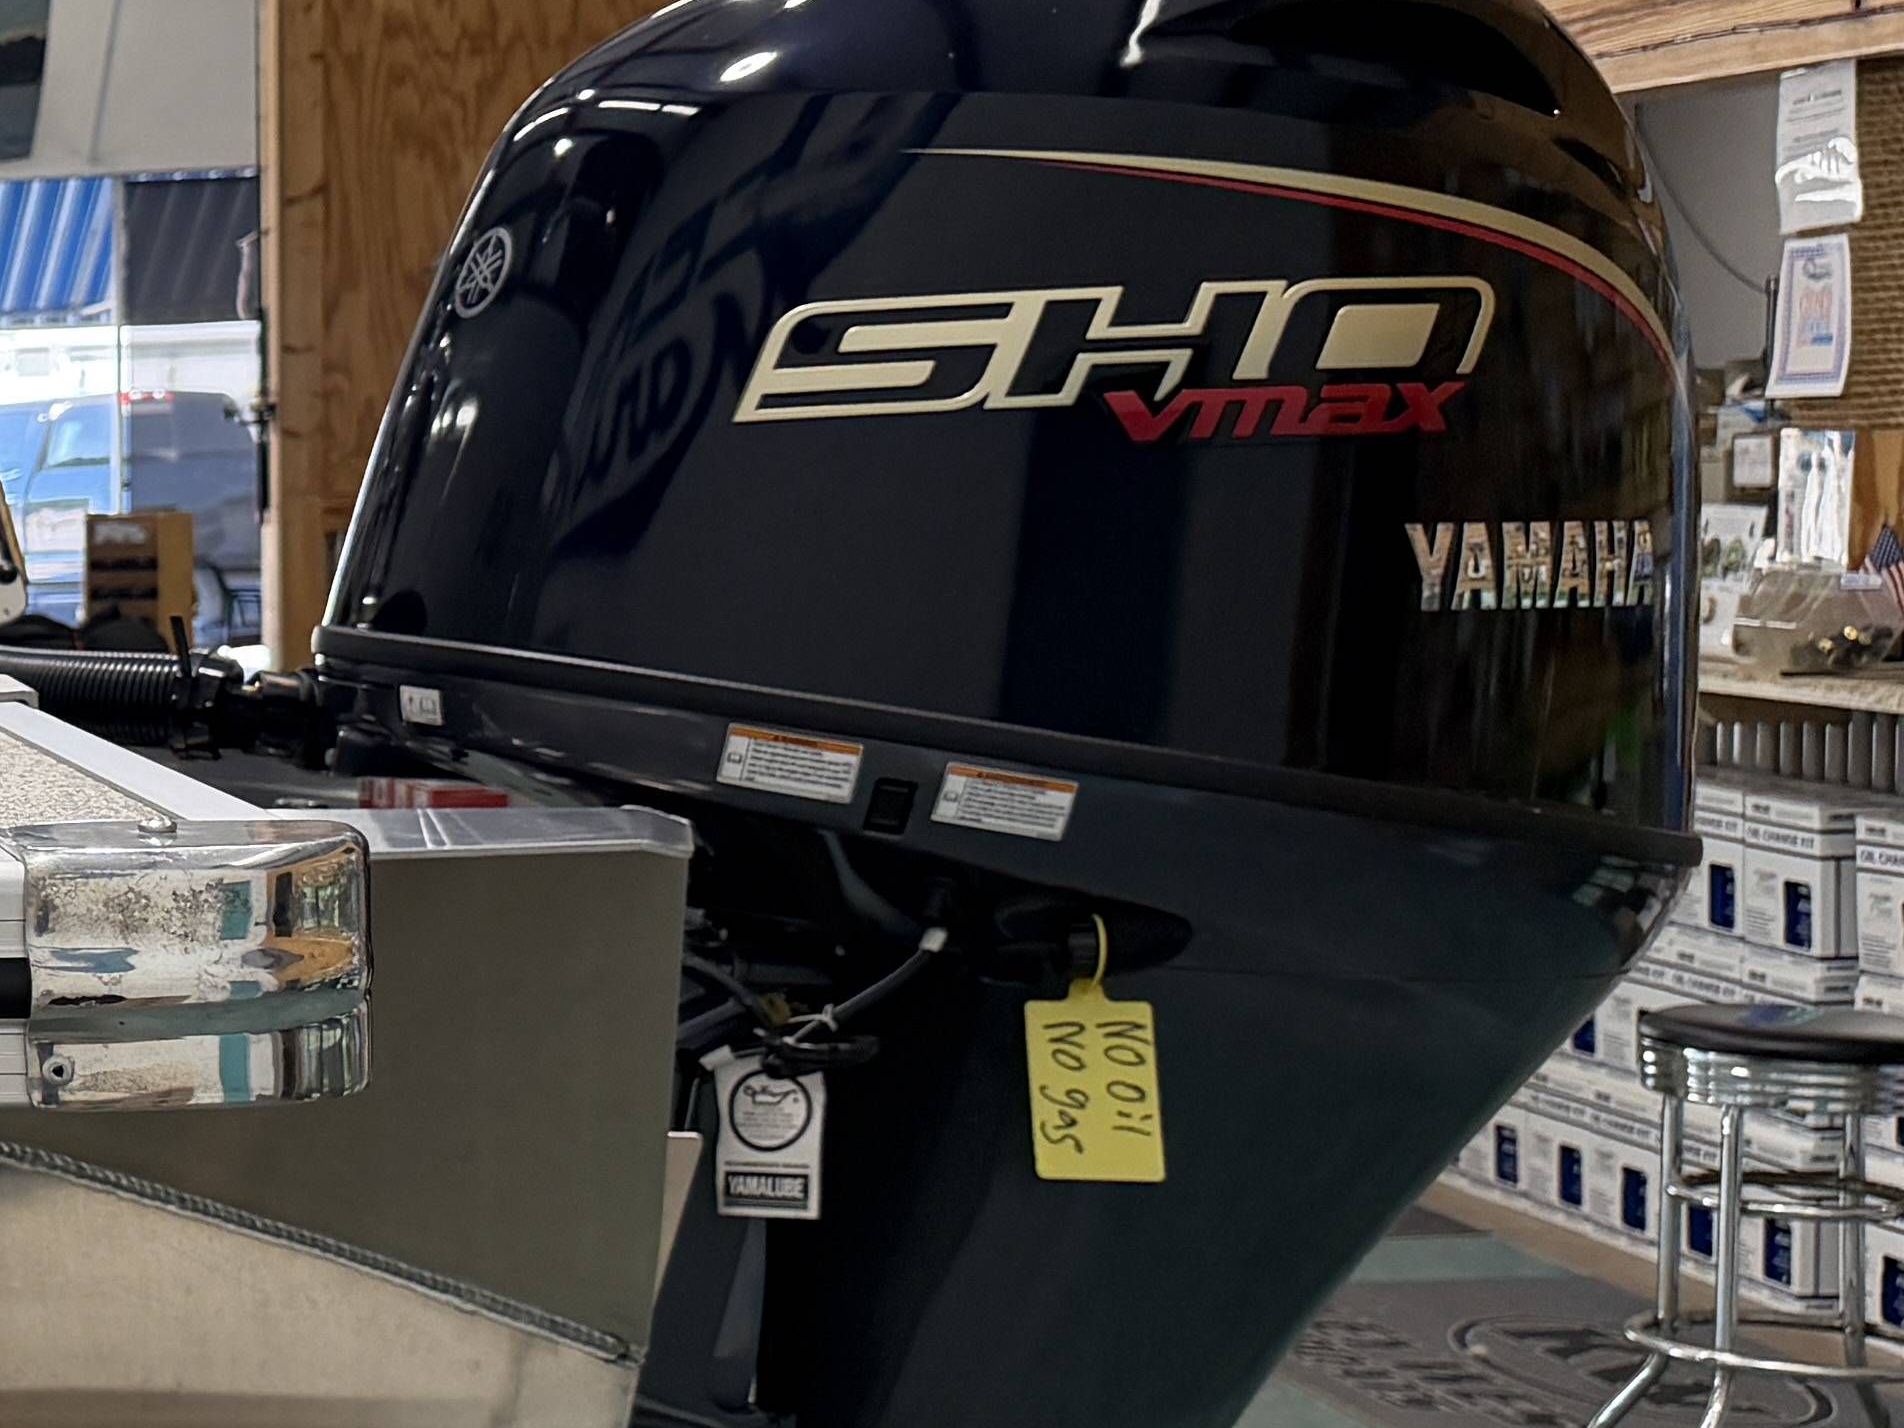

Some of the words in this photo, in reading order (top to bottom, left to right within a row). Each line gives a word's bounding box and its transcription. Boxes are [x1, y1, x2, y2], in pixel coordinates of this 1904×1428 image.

[731, 276, 1498, 424] SHO
[1403, 518, 1654, 612] YAMAHA
[1042, 1021, 1088, 1072] NO
[1095, 1020, 1152, 1067] NO
[1038, 1085, 1090, 1155] gas
